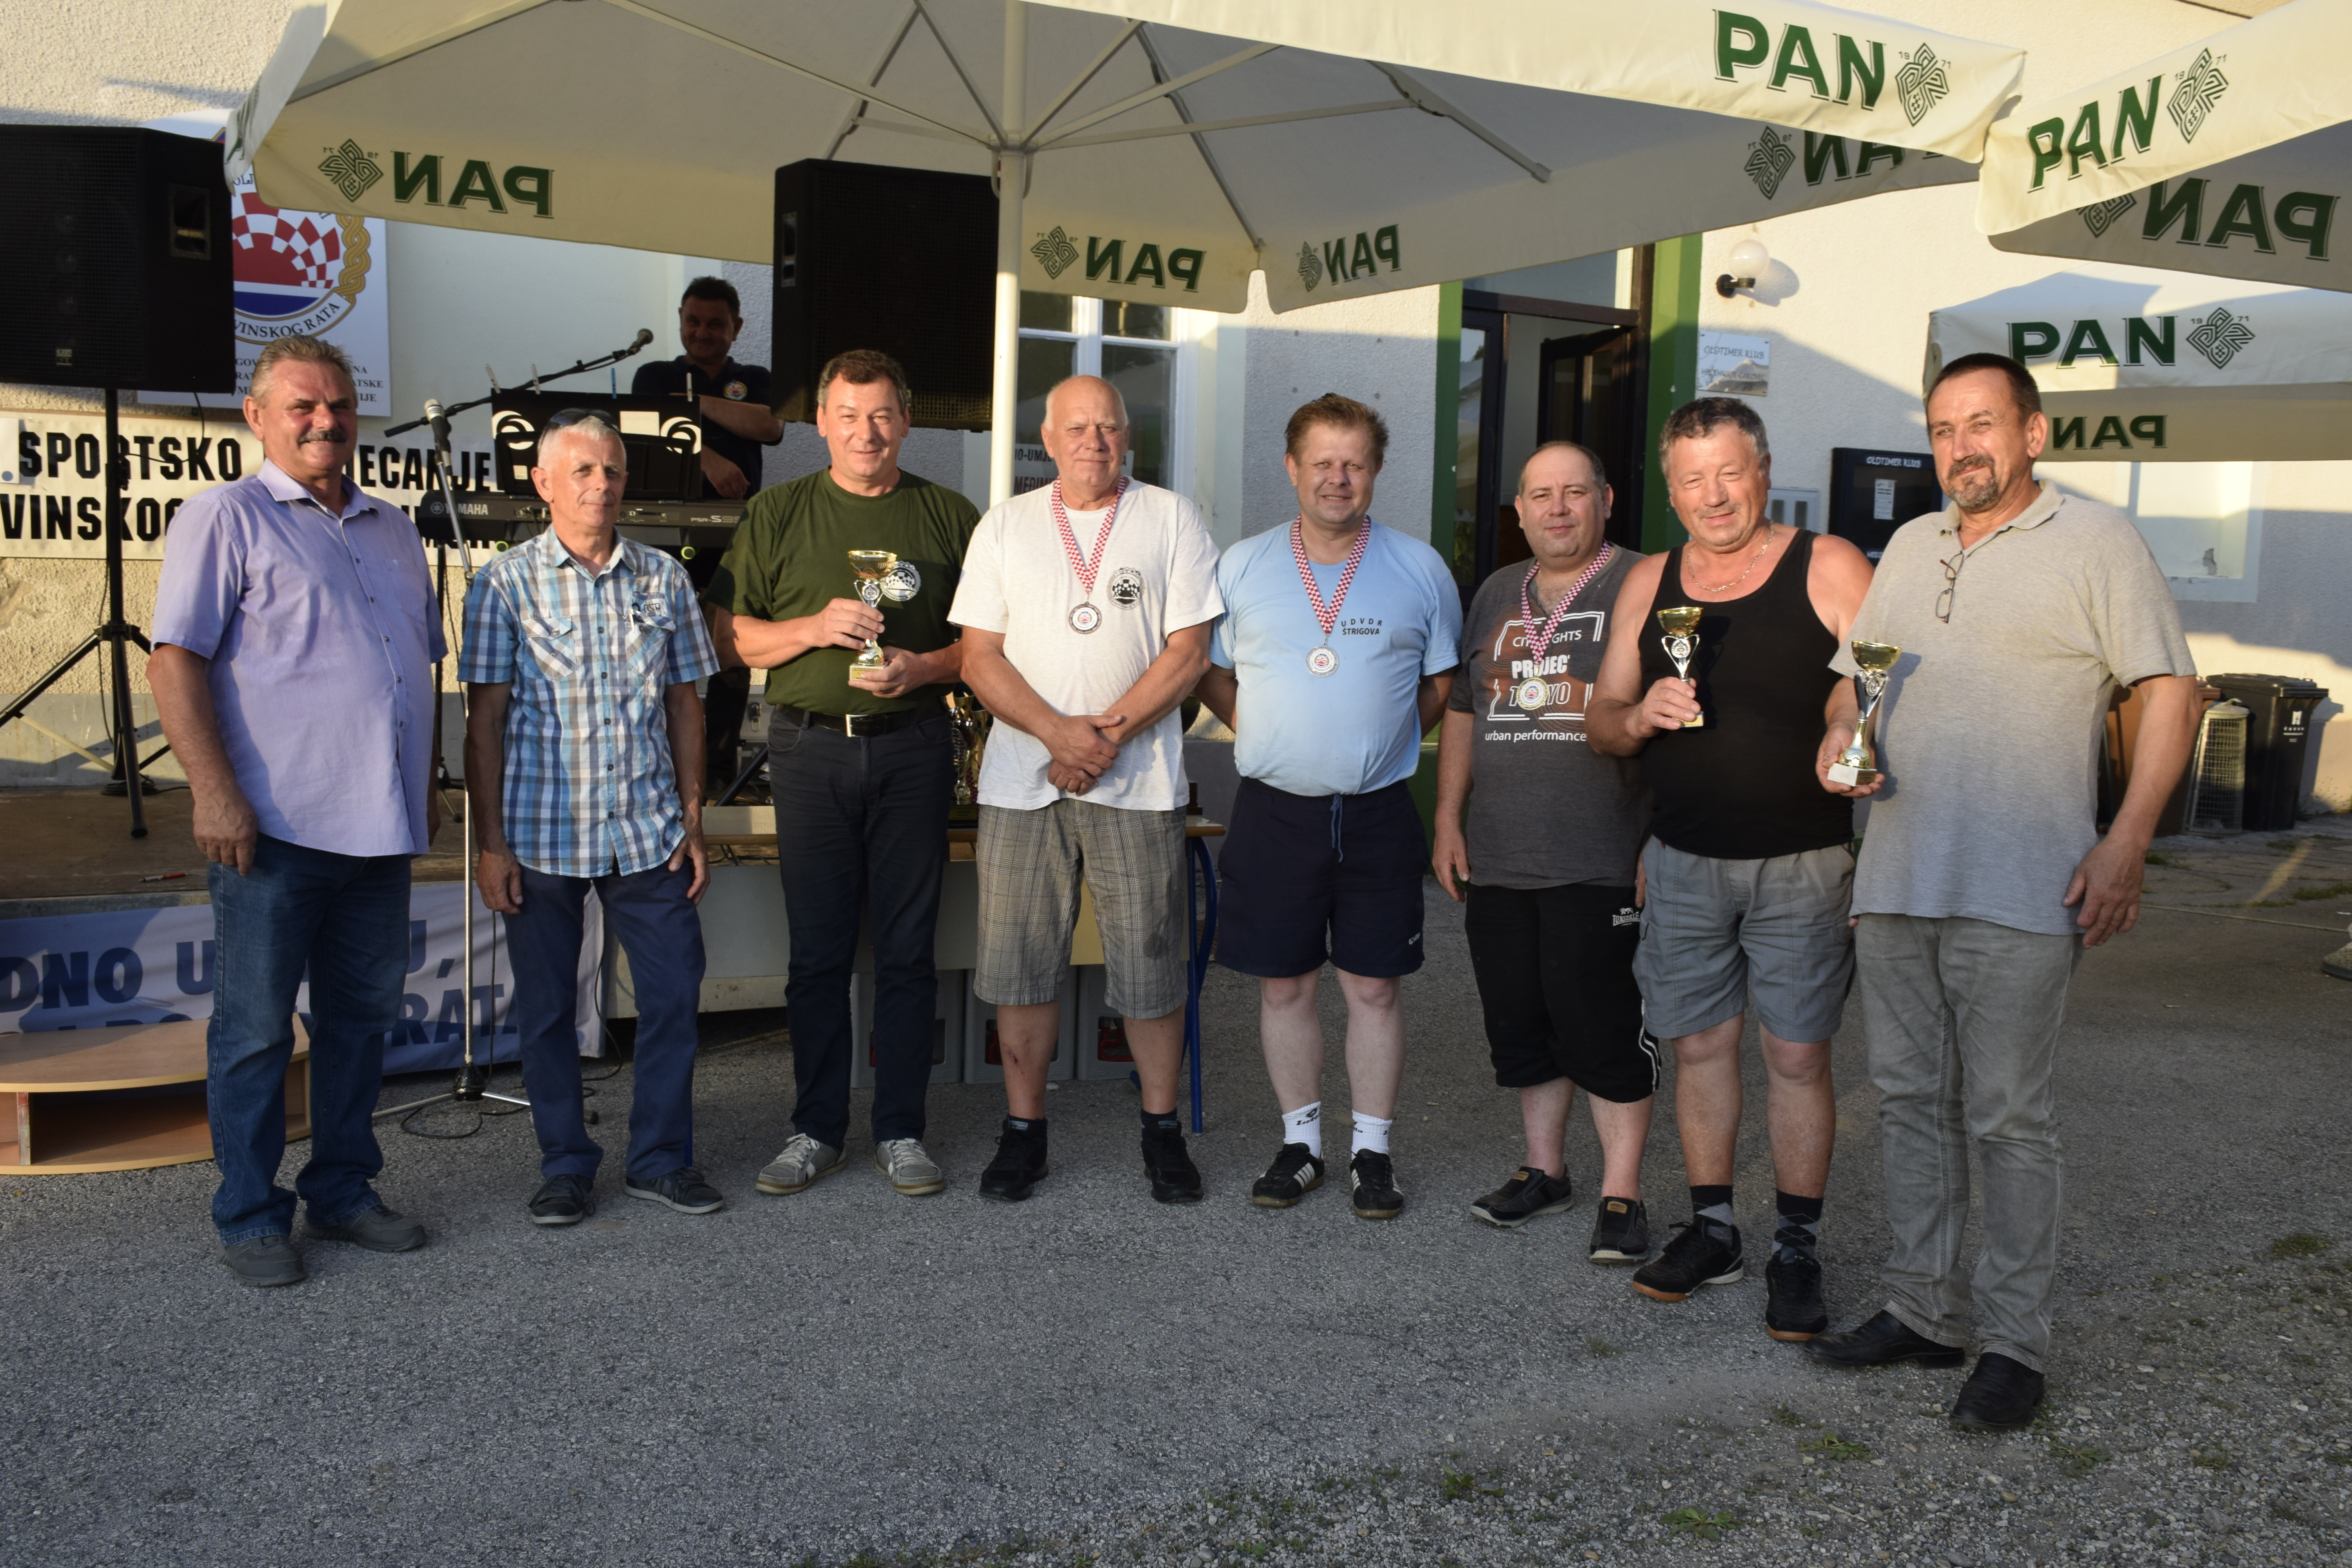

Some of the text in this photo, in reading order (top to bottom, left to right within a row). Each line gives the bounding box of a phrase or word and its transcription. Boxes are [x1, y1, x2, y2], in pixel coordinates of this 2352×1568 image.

[1712, 9, 1951, 111] PAN 19 71
[2027, 54, 2227, 193] PAN 19 71
[304, 302, 341, 331] RATA
[2007, 315, 2178, 369] PAN
[1704, 346, 1765, 359] OLDTIMER KLUB
[1867, 456, 1922, 468] OLDTIMER KLUB
[445, 503, 488, 515] YMAHA
[1342, 627, 1379, 635] ŠTRIGOVA
[1512, 637, 1530, 647] CIT
[1509, 681, 1571, 706] TYO
[1485, 729, 1587, 743] urban performance
[1612, 911, 1639, 926] LONSDALE
